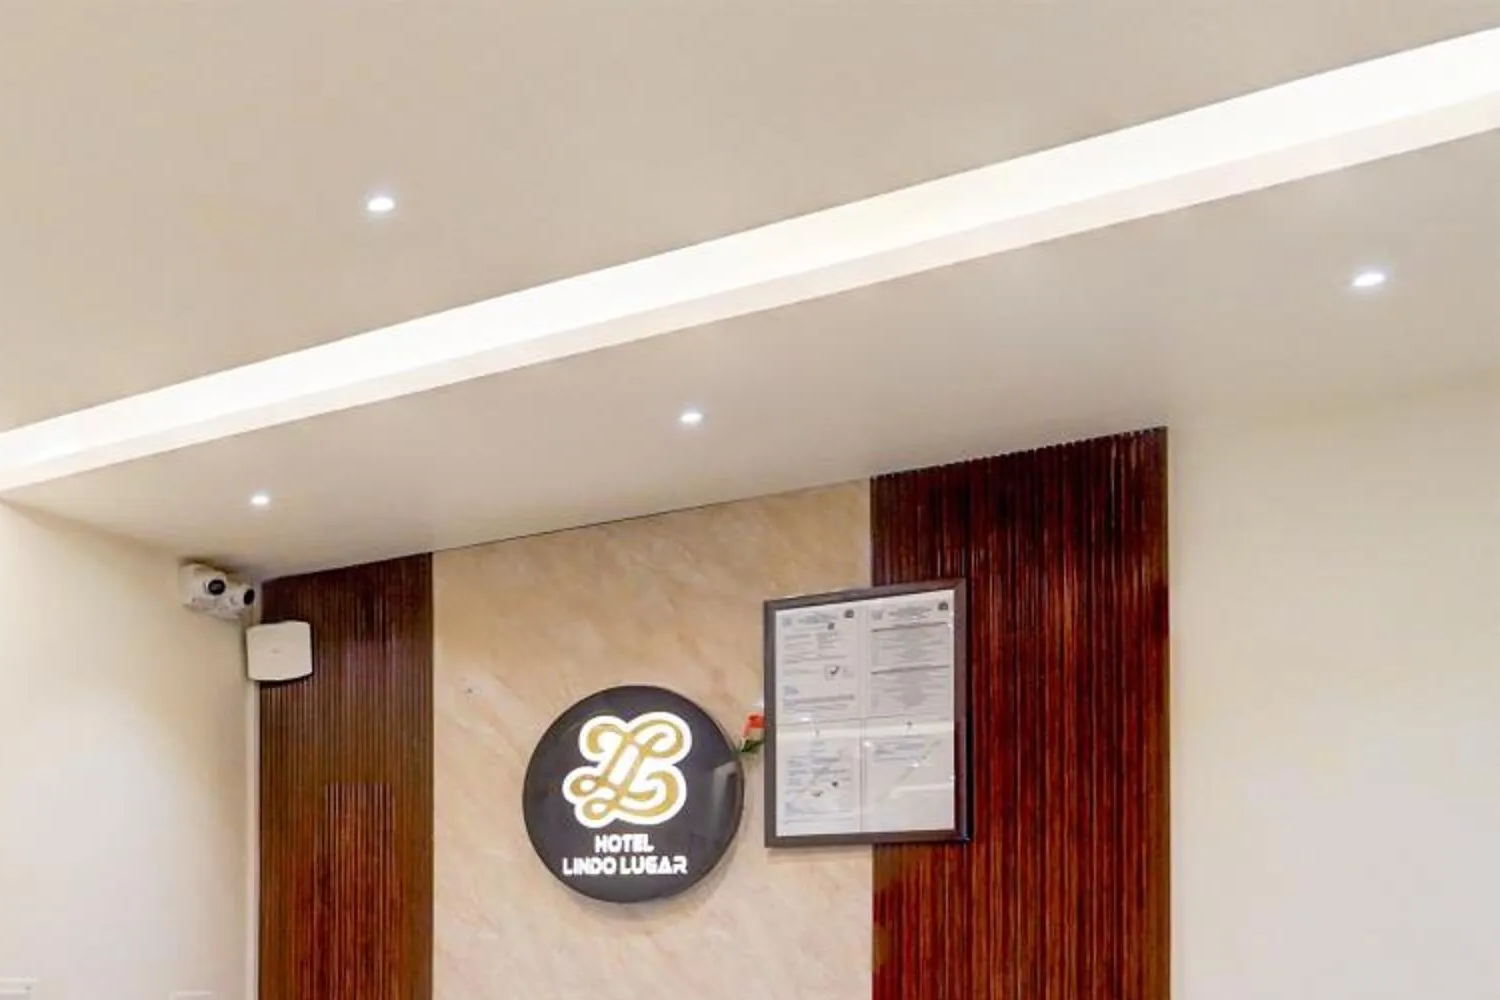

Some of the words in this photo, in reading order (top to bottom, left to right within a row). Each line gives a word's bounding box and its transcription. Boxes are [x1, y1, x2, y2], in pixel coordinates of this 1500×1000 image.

[594, 833, 655, 853] HOTEL
[562, 856, 617, 876] LINDO
[619, 855, 688, 875] LUGAR
